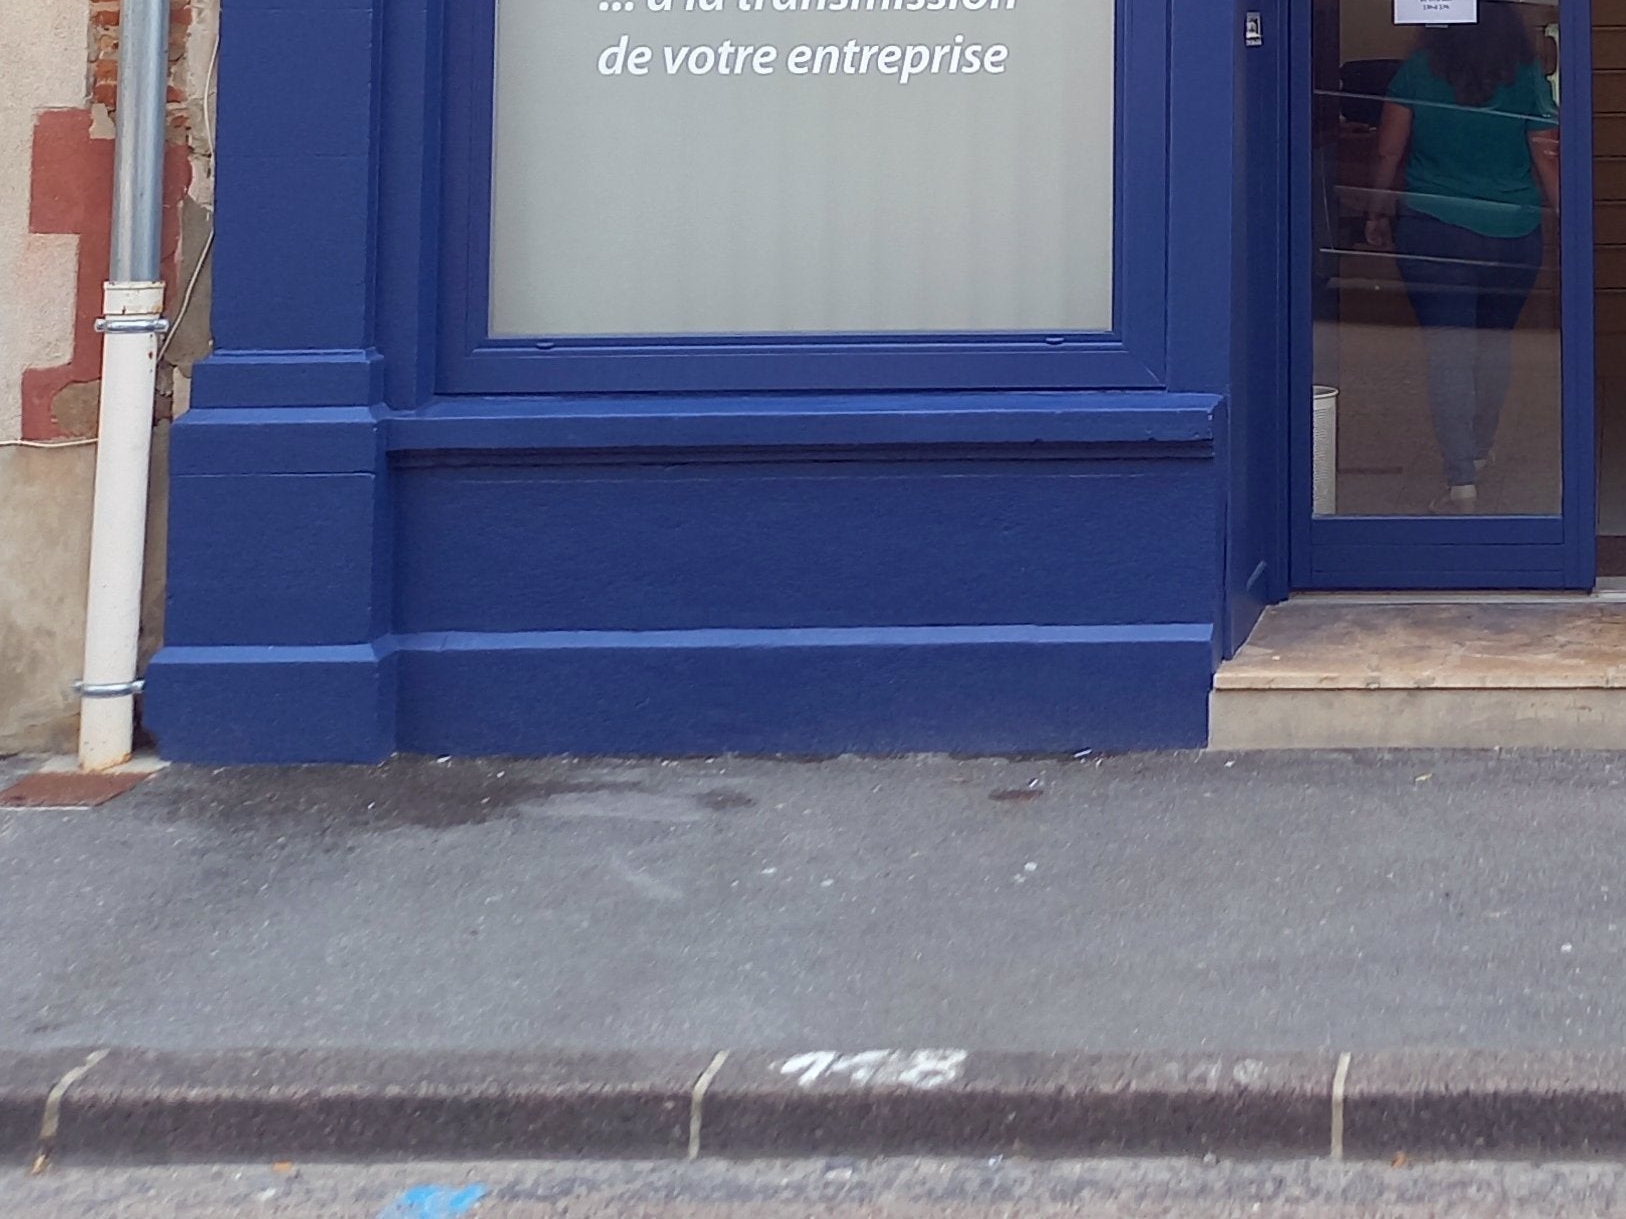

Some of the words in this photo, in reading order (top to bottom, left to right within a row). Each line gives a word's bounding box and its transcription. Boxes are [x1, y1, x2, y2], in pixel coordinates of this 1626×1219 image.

[598, 0, 635, 13] ...
[597, 34, 653, 76] de
[663, 39, 778, 76] votre
[786, 33, 1009, 85] entreprise
